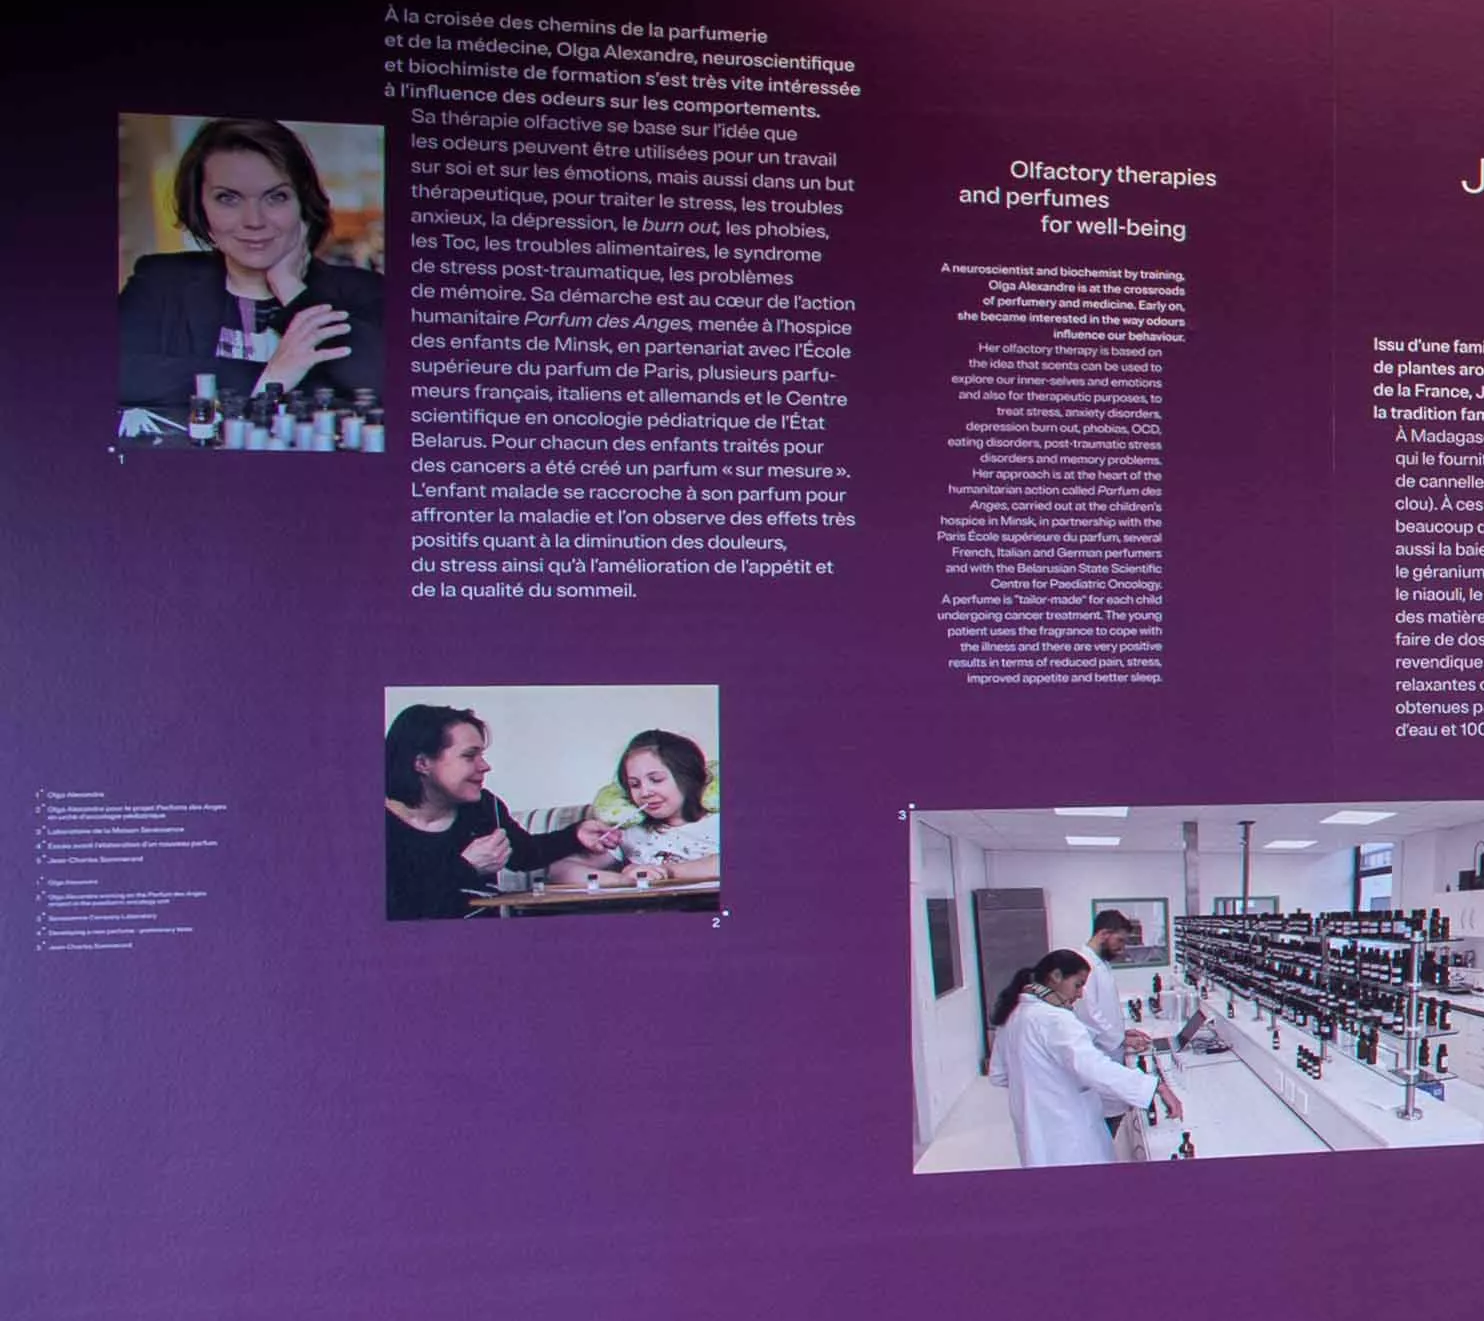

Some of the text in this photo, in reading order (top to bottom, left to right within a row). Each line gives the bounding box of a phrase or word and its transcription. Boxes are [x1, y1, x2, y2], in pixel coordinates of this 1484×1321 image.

[384, 6, 768, 44] À la croisée des chemins de la parfumerie
[1010, 160, 1217, 189] Olfactory therapies
[959, 186, 1109, 209] and perfumes
[1041, 215, 1186, 242] for well-being
[941, 262, 1185, 282] A neuroscientist and biochemist by training,
[1373, 337, 1404, 351] Issu
[1408, 338, 1450, 353] d'une
[118, 453, 125, 465] 1
[411, 582, 637, 600] de la qualité du sommeil.
[898, 809, 907, 821] 3
[712, 917, 720, 928] 2
